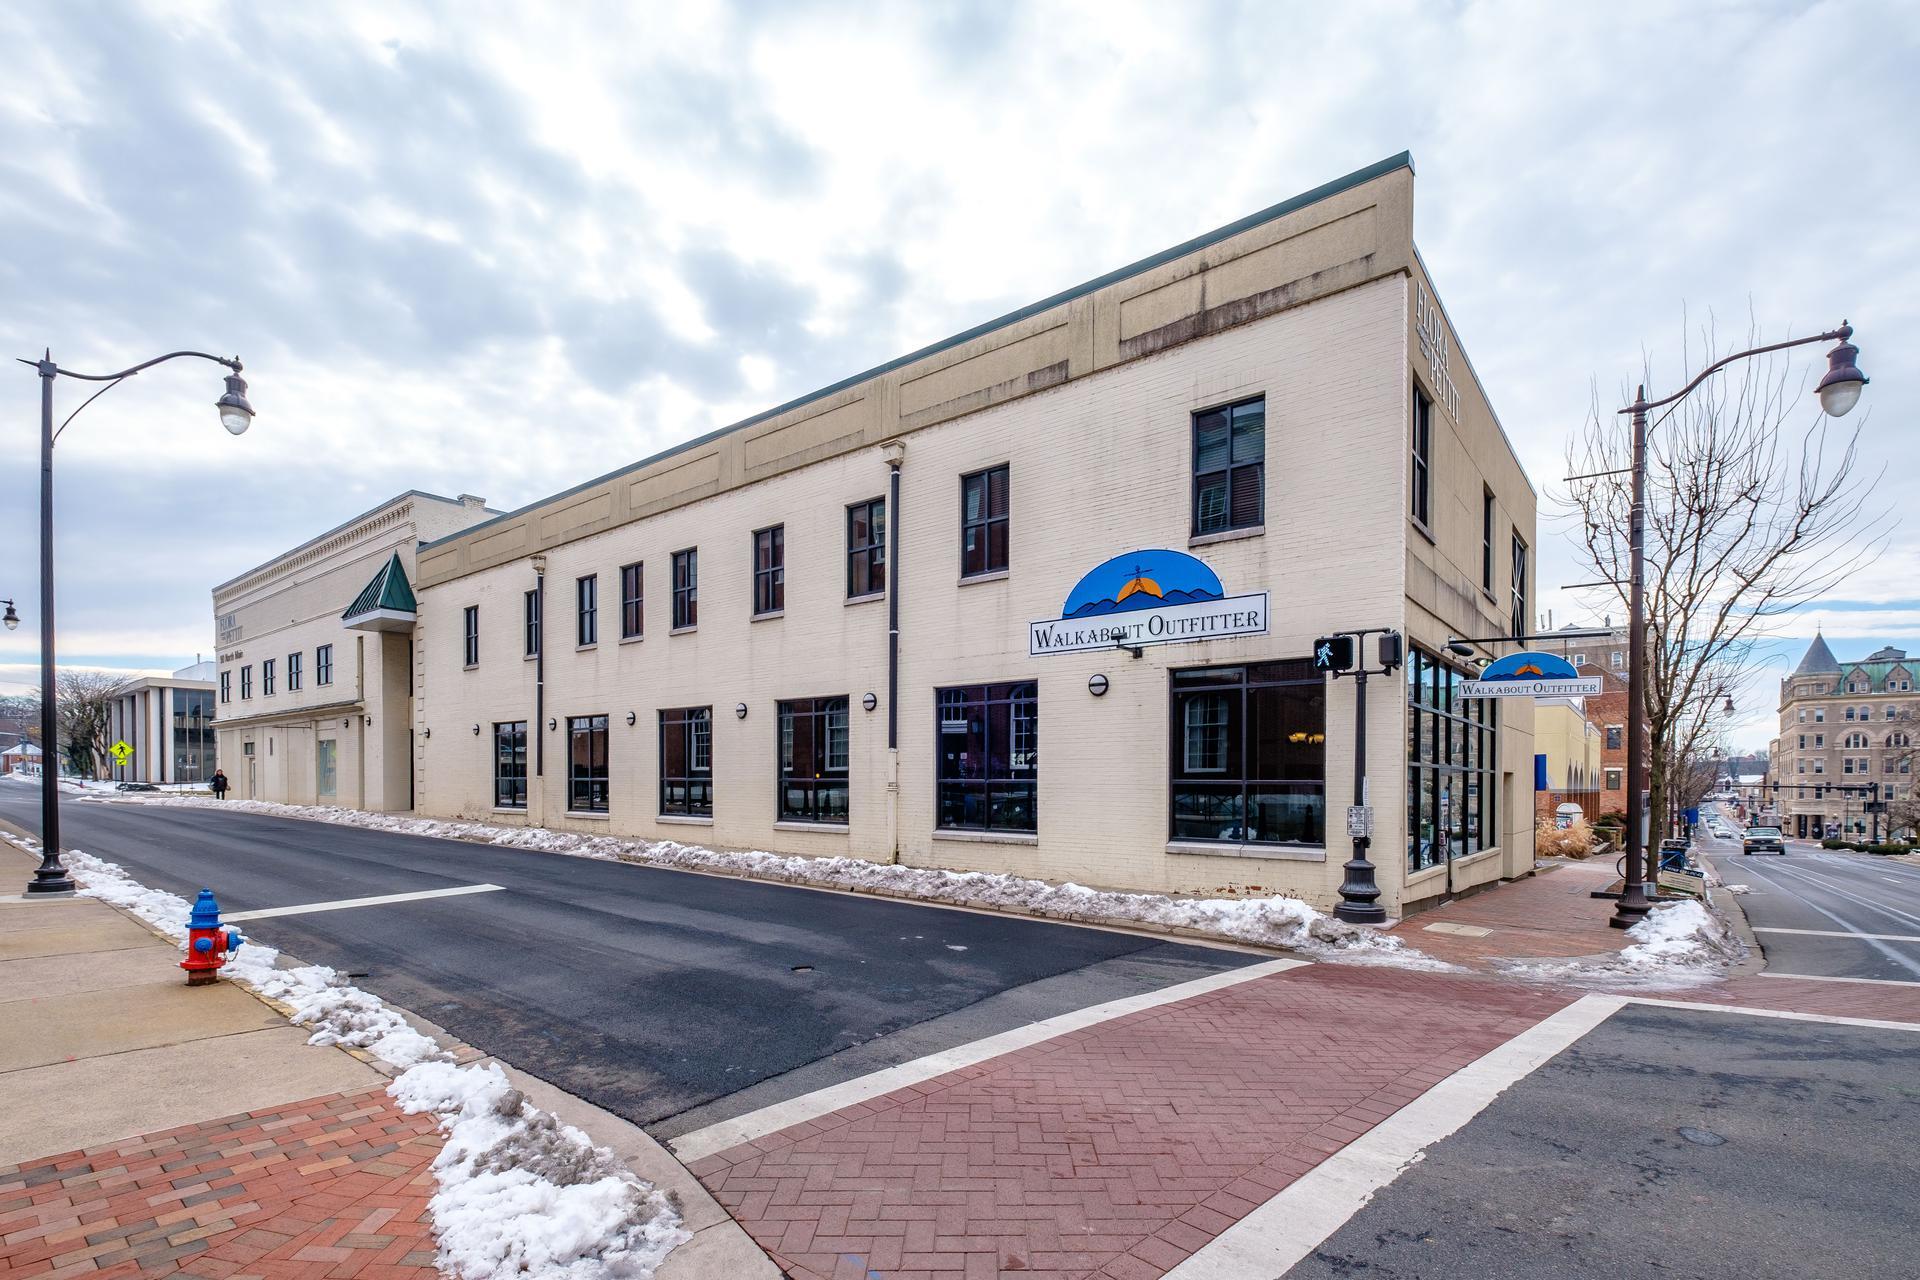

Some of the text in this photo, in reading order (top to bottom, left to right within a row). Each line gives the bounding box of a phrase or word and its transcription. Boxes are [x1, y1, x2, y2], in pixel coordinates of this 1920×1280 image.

[1416, 280, 1449, 371] FLORA
[1430, 346, 1461, 425] PETTIT
[1035, 611, 1259, 648] WALKABOUT OUTFITTER
[1462, 683, 1597, 695] WALKABOUT OUTFITTER
